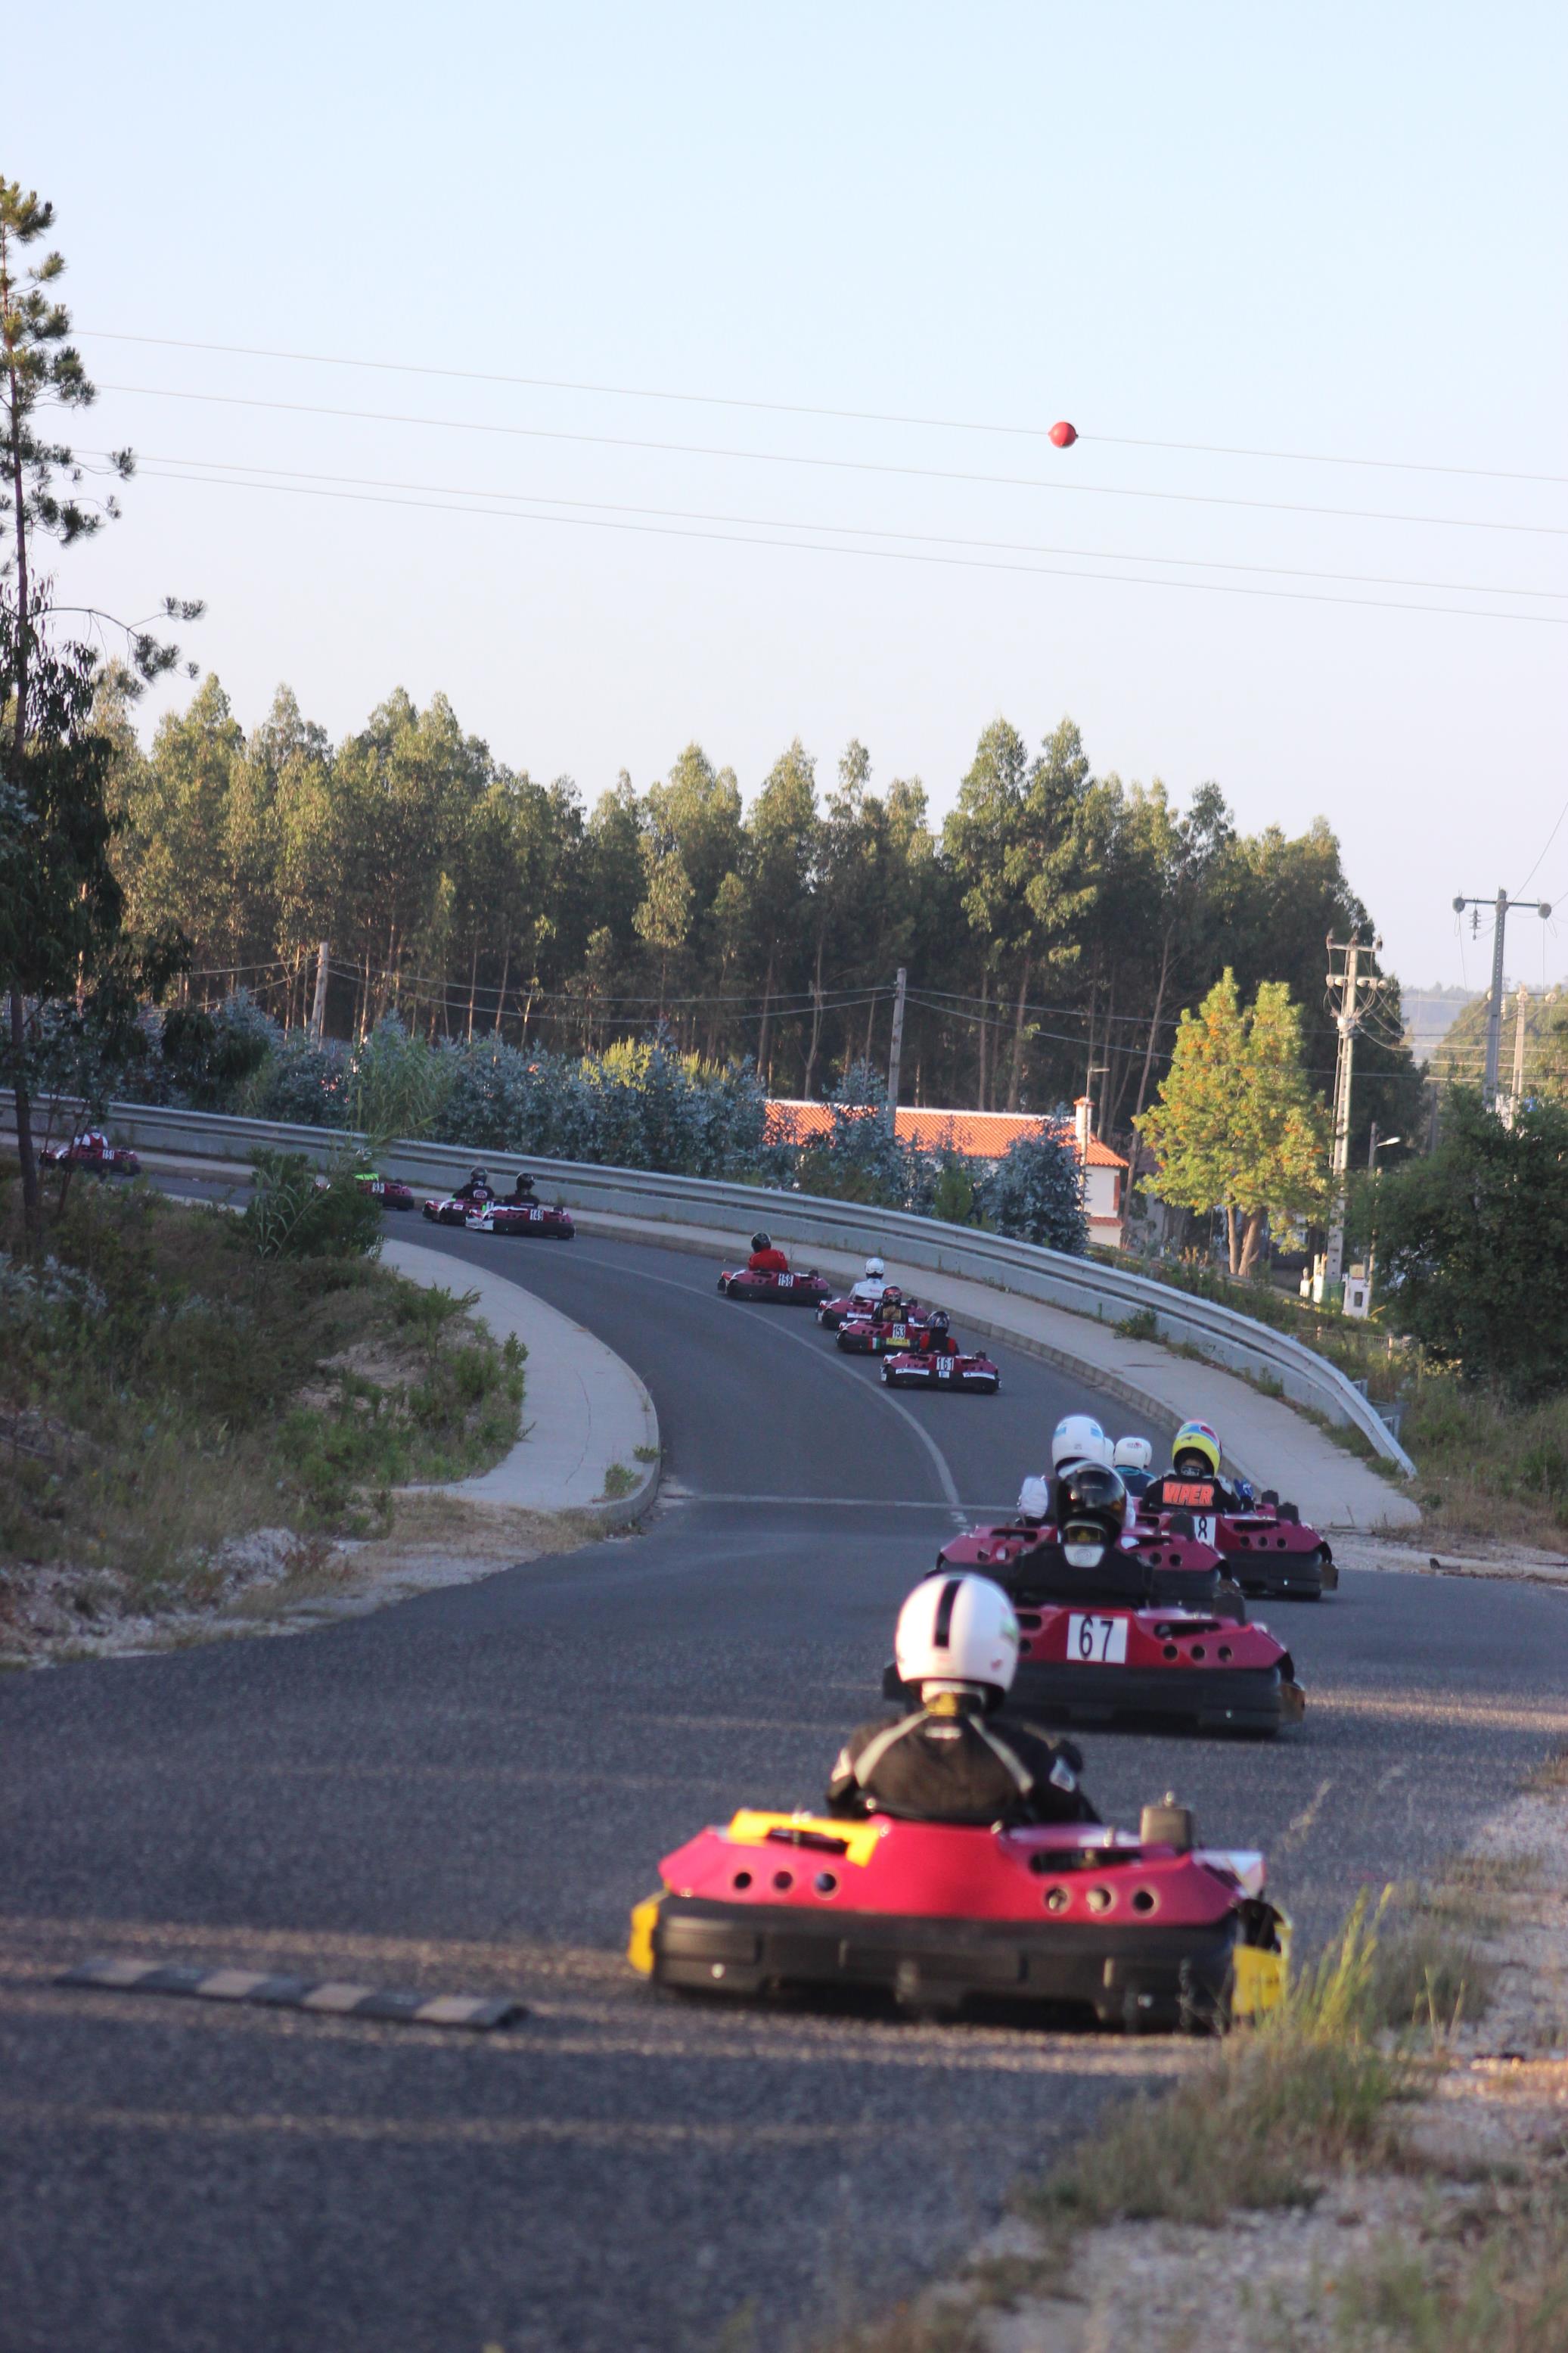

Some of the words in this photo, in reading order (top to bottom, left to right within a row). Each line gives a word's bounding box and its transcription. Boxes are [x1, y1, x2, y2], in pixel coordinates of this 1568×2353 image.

[779, 1273, 792, 1286] 158
[893, 1326, 905, 1338] 153
[1163, 1481, 1215, 1506] VIPER
[1079, 1614, 1114, 1662] 67
